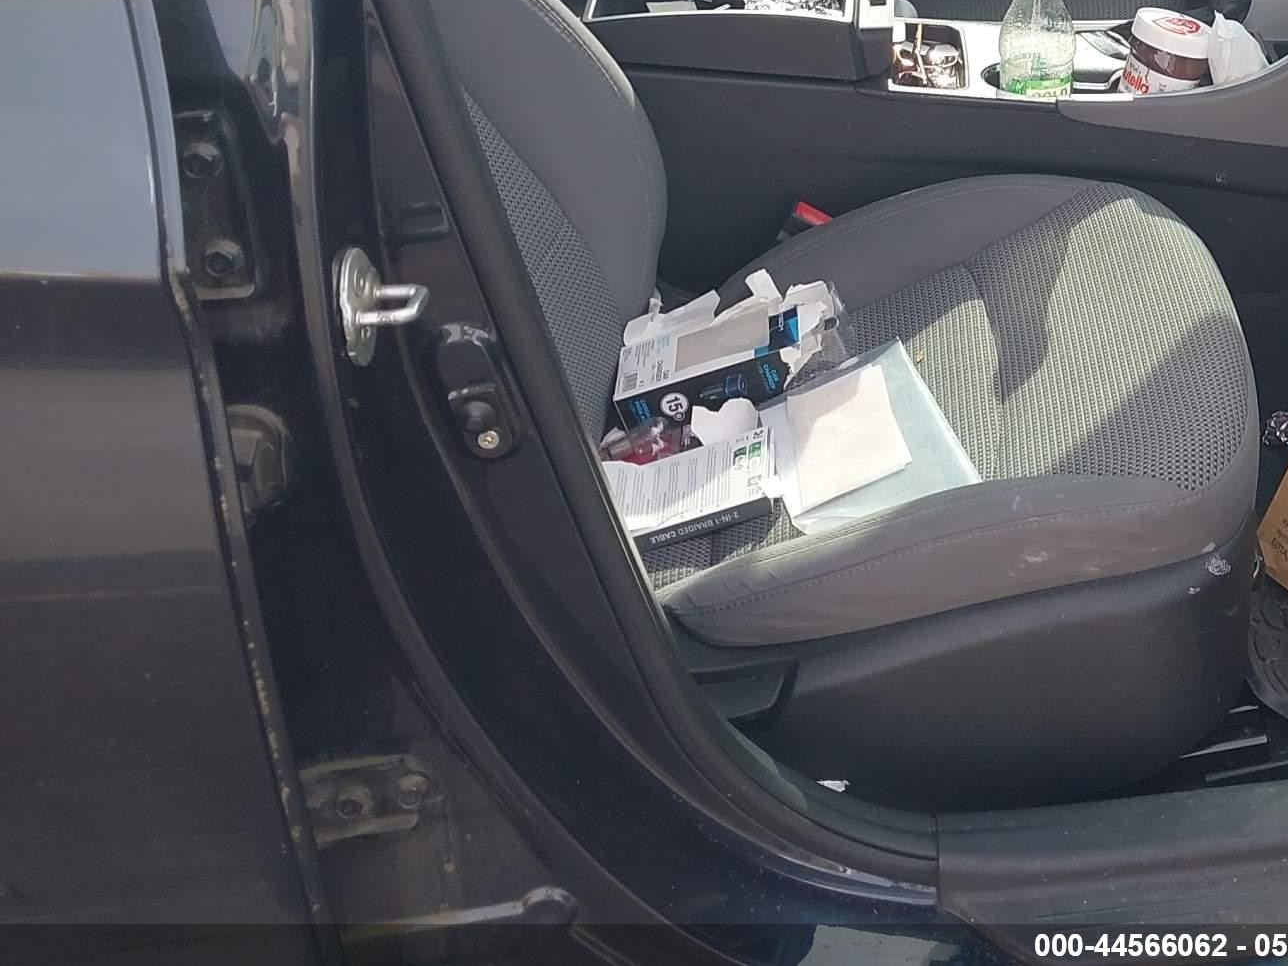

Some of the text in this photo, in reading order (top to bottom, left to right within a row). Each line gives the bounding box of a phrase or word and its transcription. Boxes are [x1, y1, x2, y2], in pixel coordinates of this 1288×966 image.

[1123, 71, 1150, 94] utella
[664, 395, 683, 412] 15
[677, 518, 713, 536] BRAIDED
[648, 530, 677, 544] CABLE
